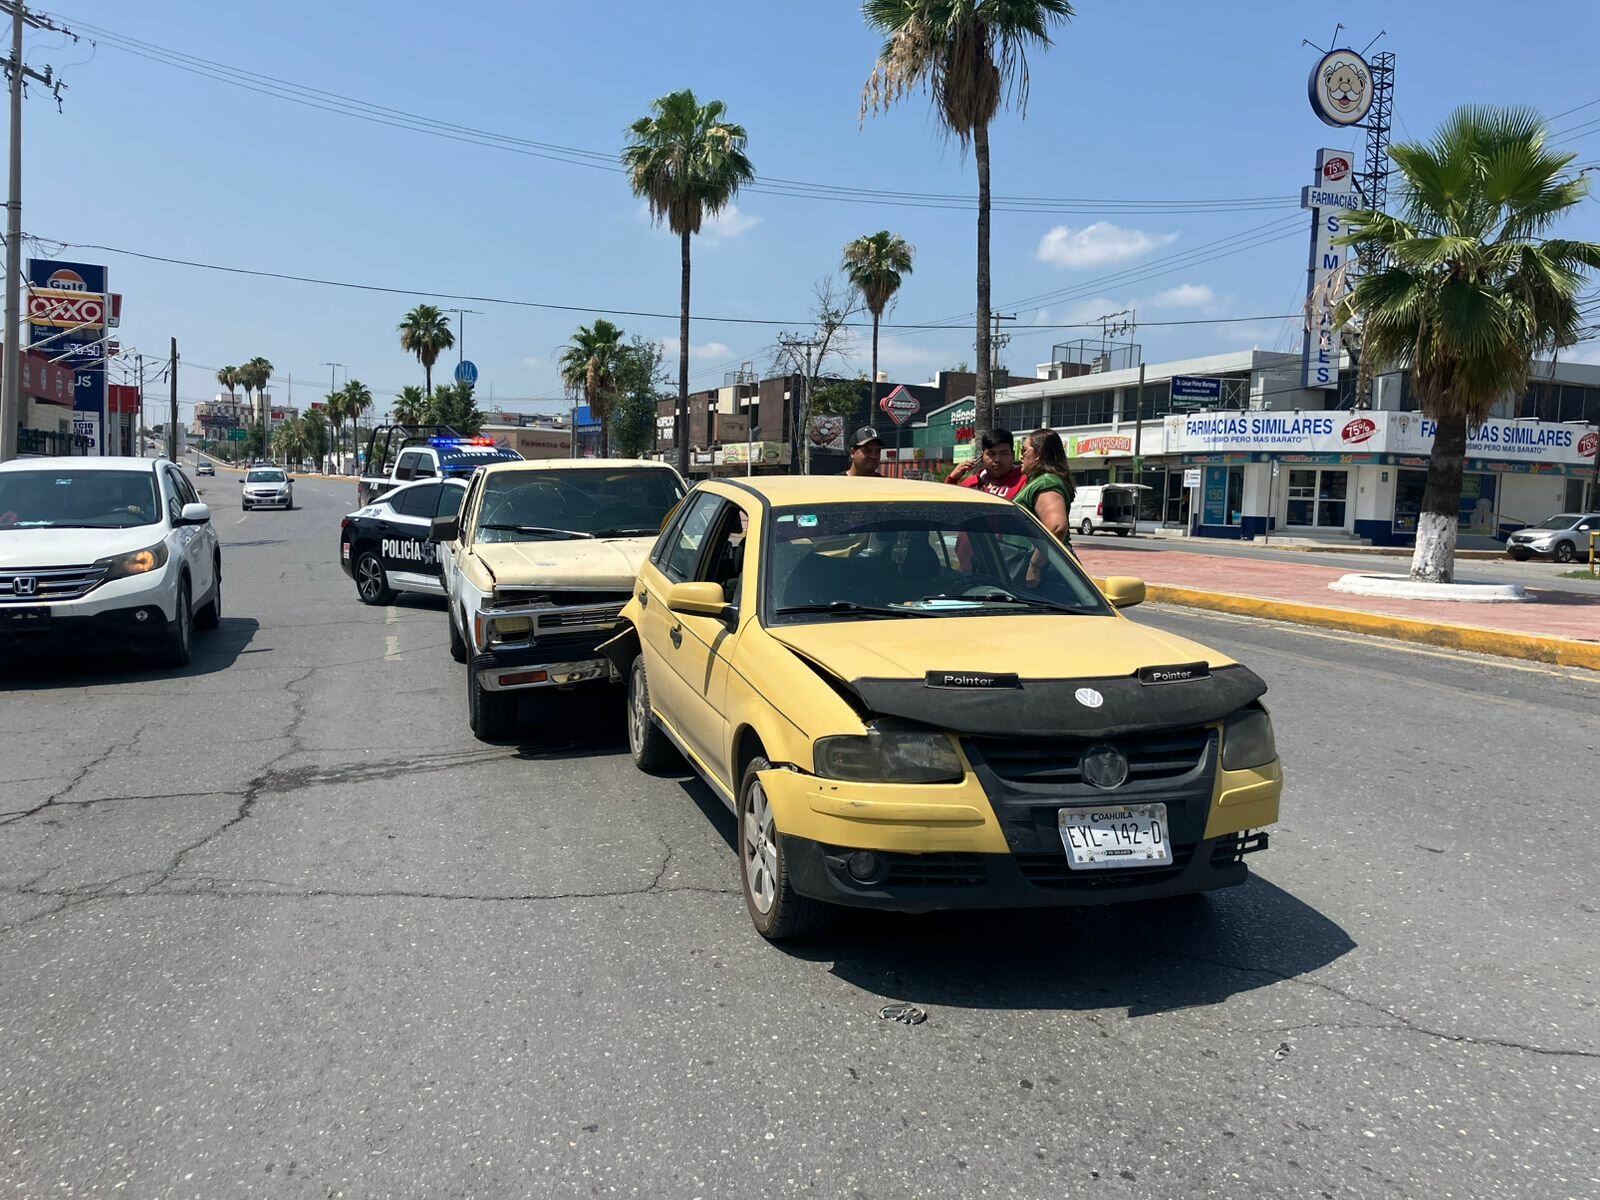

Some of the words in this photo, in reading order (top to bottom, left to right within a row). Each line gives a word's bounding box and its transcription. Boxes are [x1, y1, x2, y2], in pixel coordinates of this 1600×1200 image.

[1311, 190, 1358, 209] FARMACIAS
[49, 280, 84, 291] Gulf
[30, 298, 101, 321] OXXO
[1187, 418, 1247, 435] FARMACIAS
[1251, 418, 1333, 434] SIMILARES
[1346, 421, 1371, 437] 75%
[1088, 437, 1130, 450] ANIVERSARIO
[1503, 427, 1572, 447] SIMILARES
[382, 538, 422, 561] POLICÍA
[944, 674, 995, 687] Pointer
[1153, 669, 1192, 681] Pointer
[1090, 811, 1133, 823] COAHUILA
[1067, 820, 1162, 848] EYL-142-D
